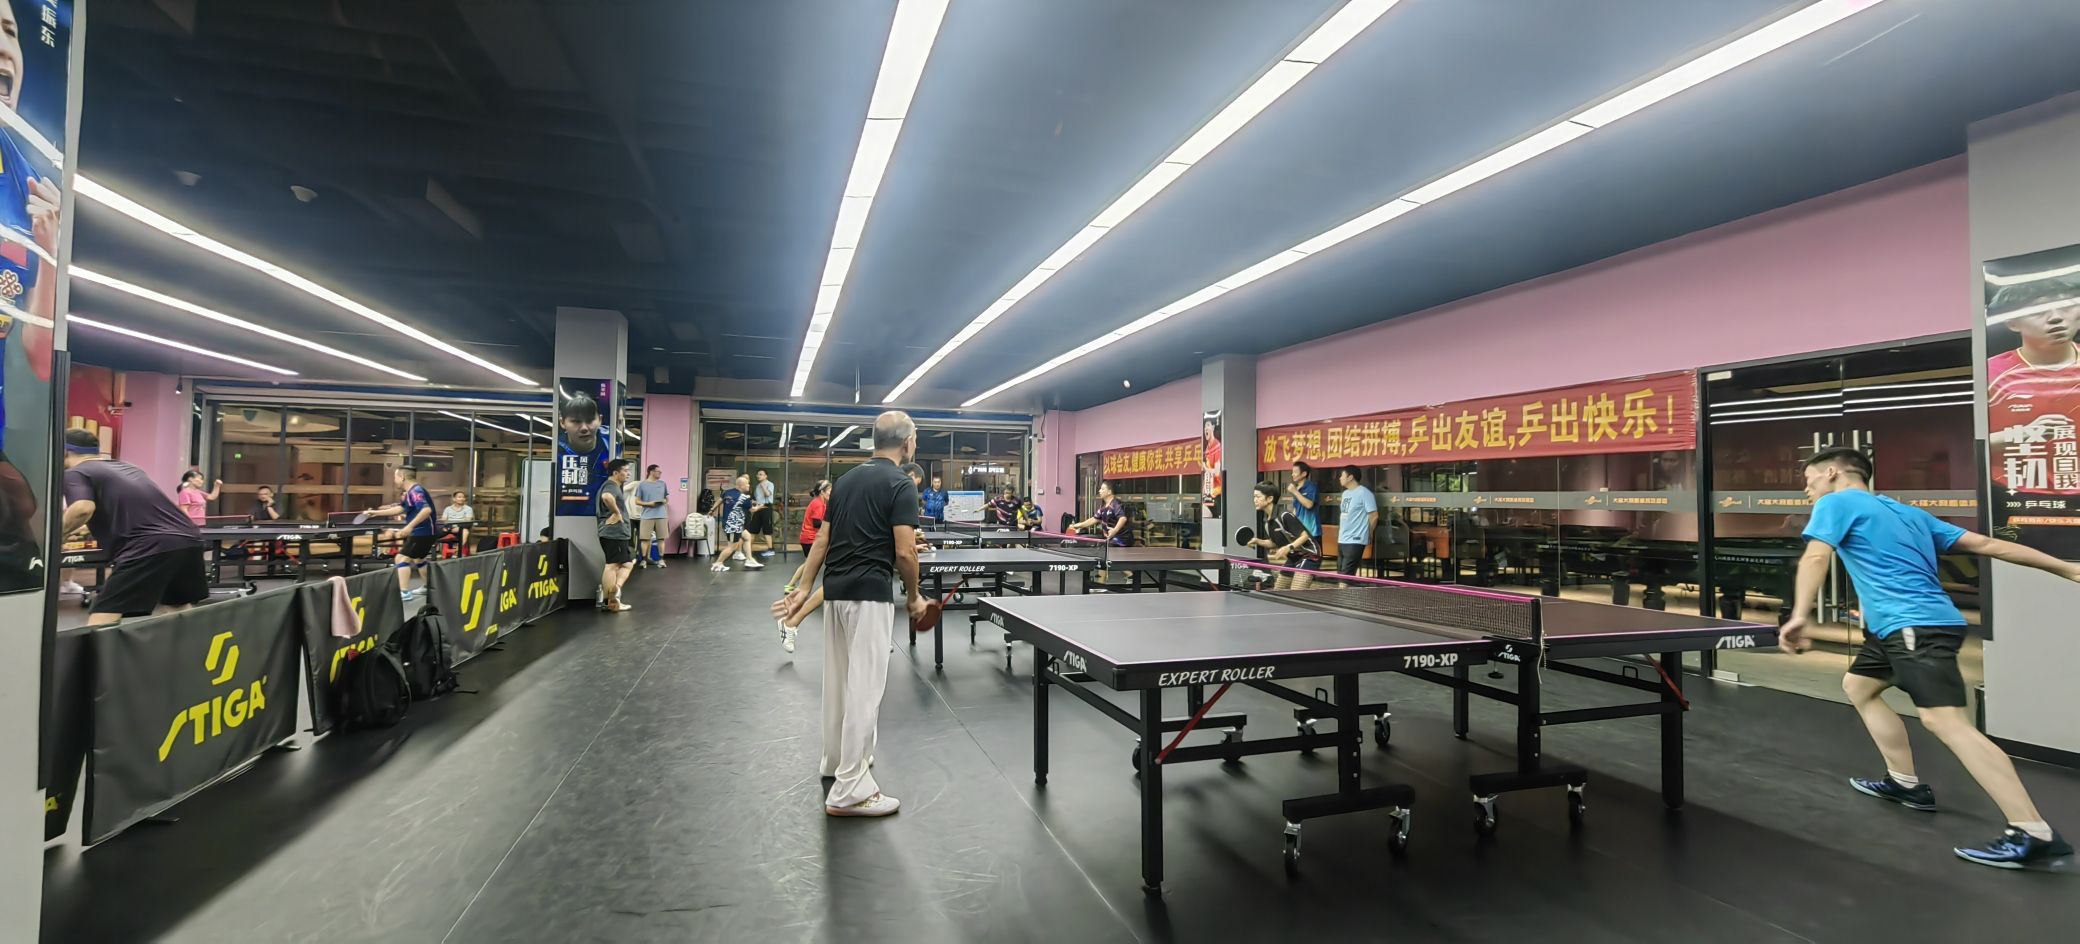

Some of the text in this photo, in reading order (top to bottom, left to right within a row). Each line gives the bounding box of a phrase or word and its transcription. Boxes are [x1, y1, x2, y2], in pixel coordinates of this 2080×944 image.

[562, 454, 580, 485] 压制
[2025, 500, 2067, 509] 乒乓球
[528, 577, 560, 599] STIGA
[500, 588, 518, 613] IGA
[990, 612, 1005, 628] STIGA
[1715, 634, 1756, 649] STIGA
[1063, 650, 1088, 672] STIGA
[1403, 653, 1458, 669] 7190-XP
[1497, 651, 1521, 662] STIGA
[1158, 665, 1276, 687] EXPERT ROLLER
[159, 678, 267, 763] STIGA
